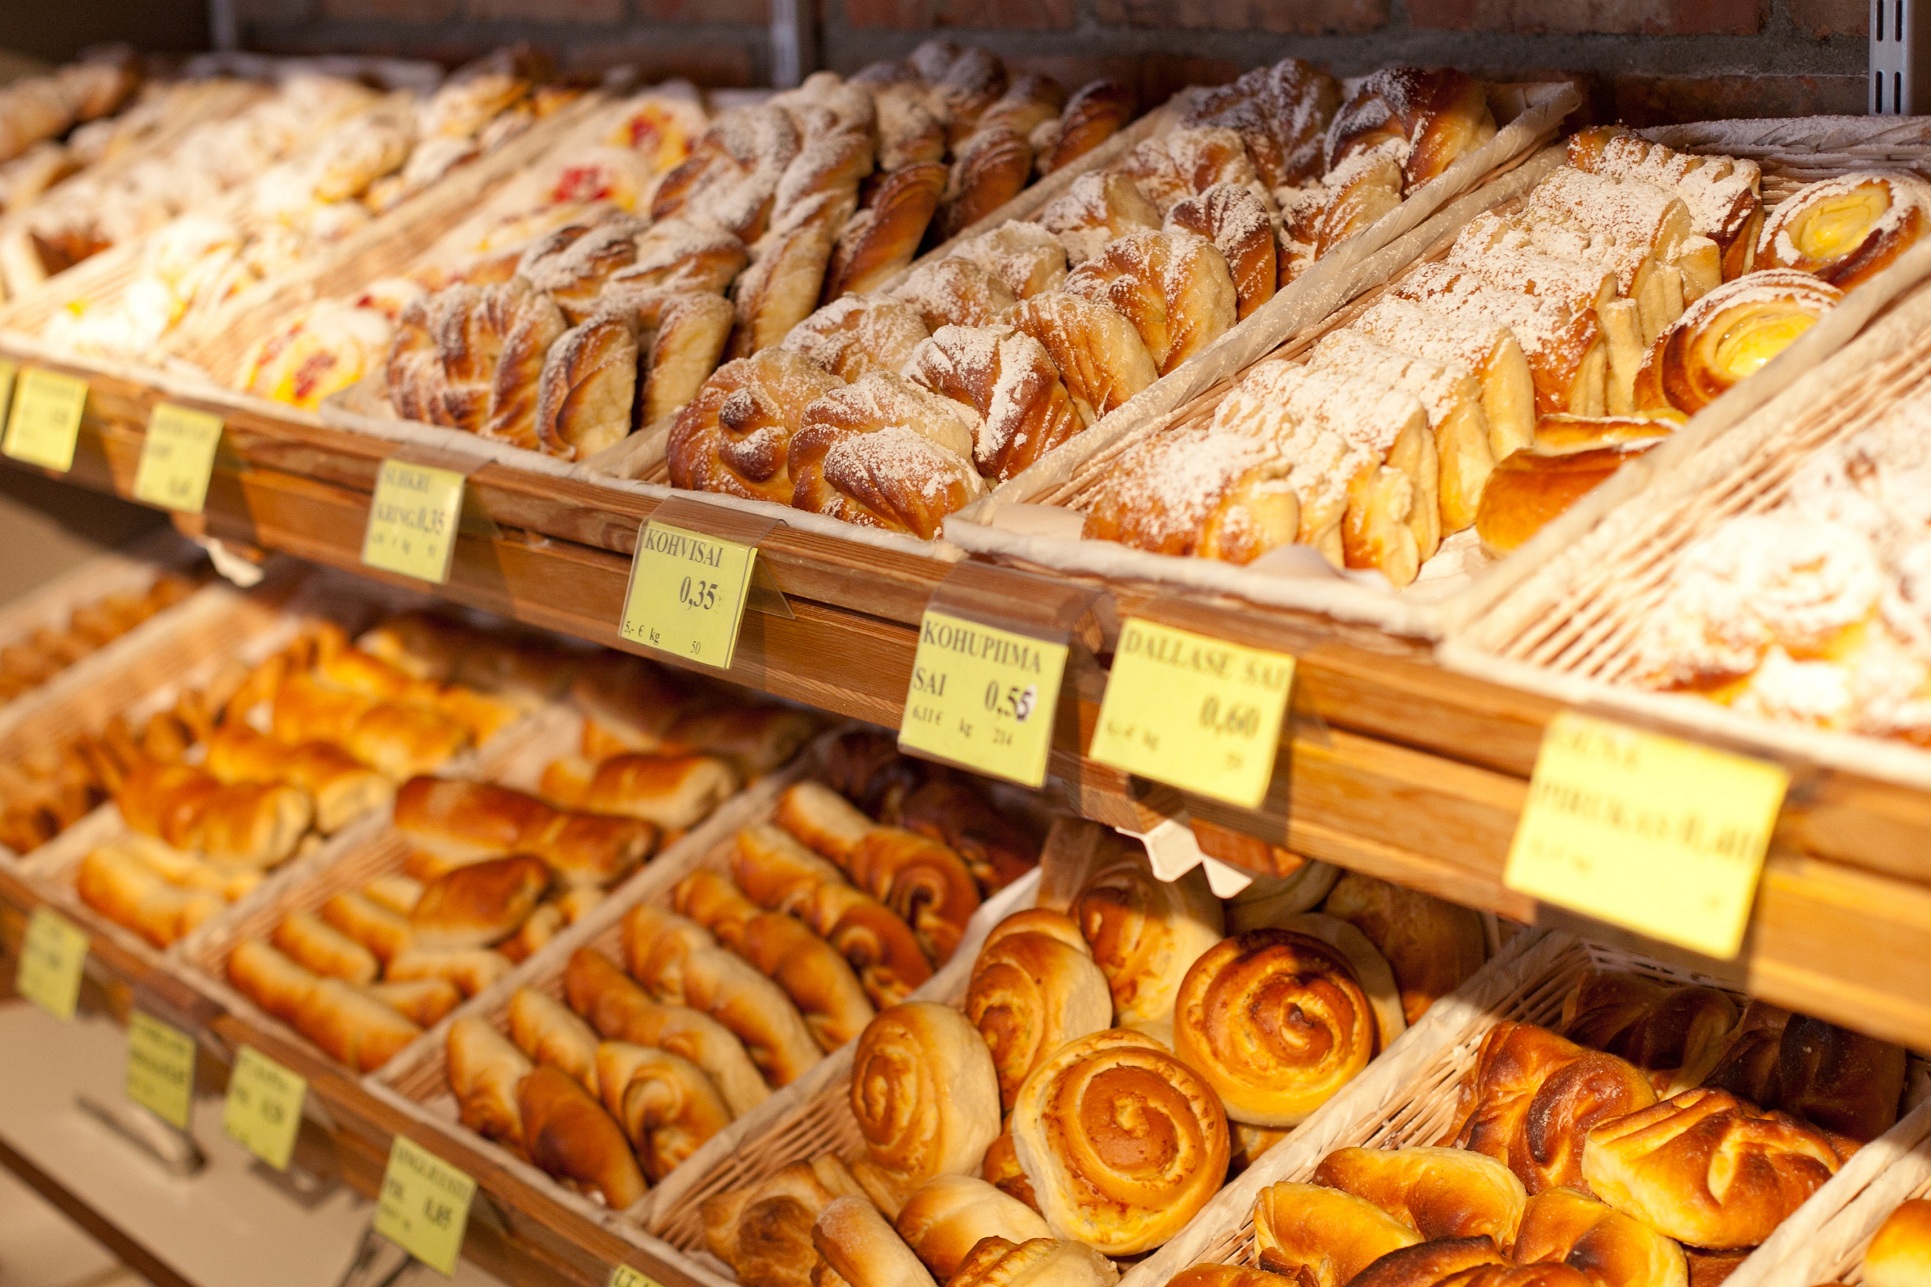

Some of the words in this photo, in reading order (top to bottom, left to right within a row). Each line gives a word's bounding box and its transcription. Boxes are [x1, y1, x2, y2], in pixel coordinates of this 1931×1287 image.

[417, 507, 445, 536] 0,35
[644, 528, 724, 568] KOHVISAI
[680, 576, 718, 611] 0,35
[649, 628, 660, 645] kg
[922, 620, 1042, 674] KOHUPIIMA
[1123, 628, 1232, 679] DALLASE
[1243, 656, 1288, 690] SAI
[913, 667, 947, 697] SAI
[959, 718, 973, 739] kg
[1199, 693, 1261, 741] 0,60
